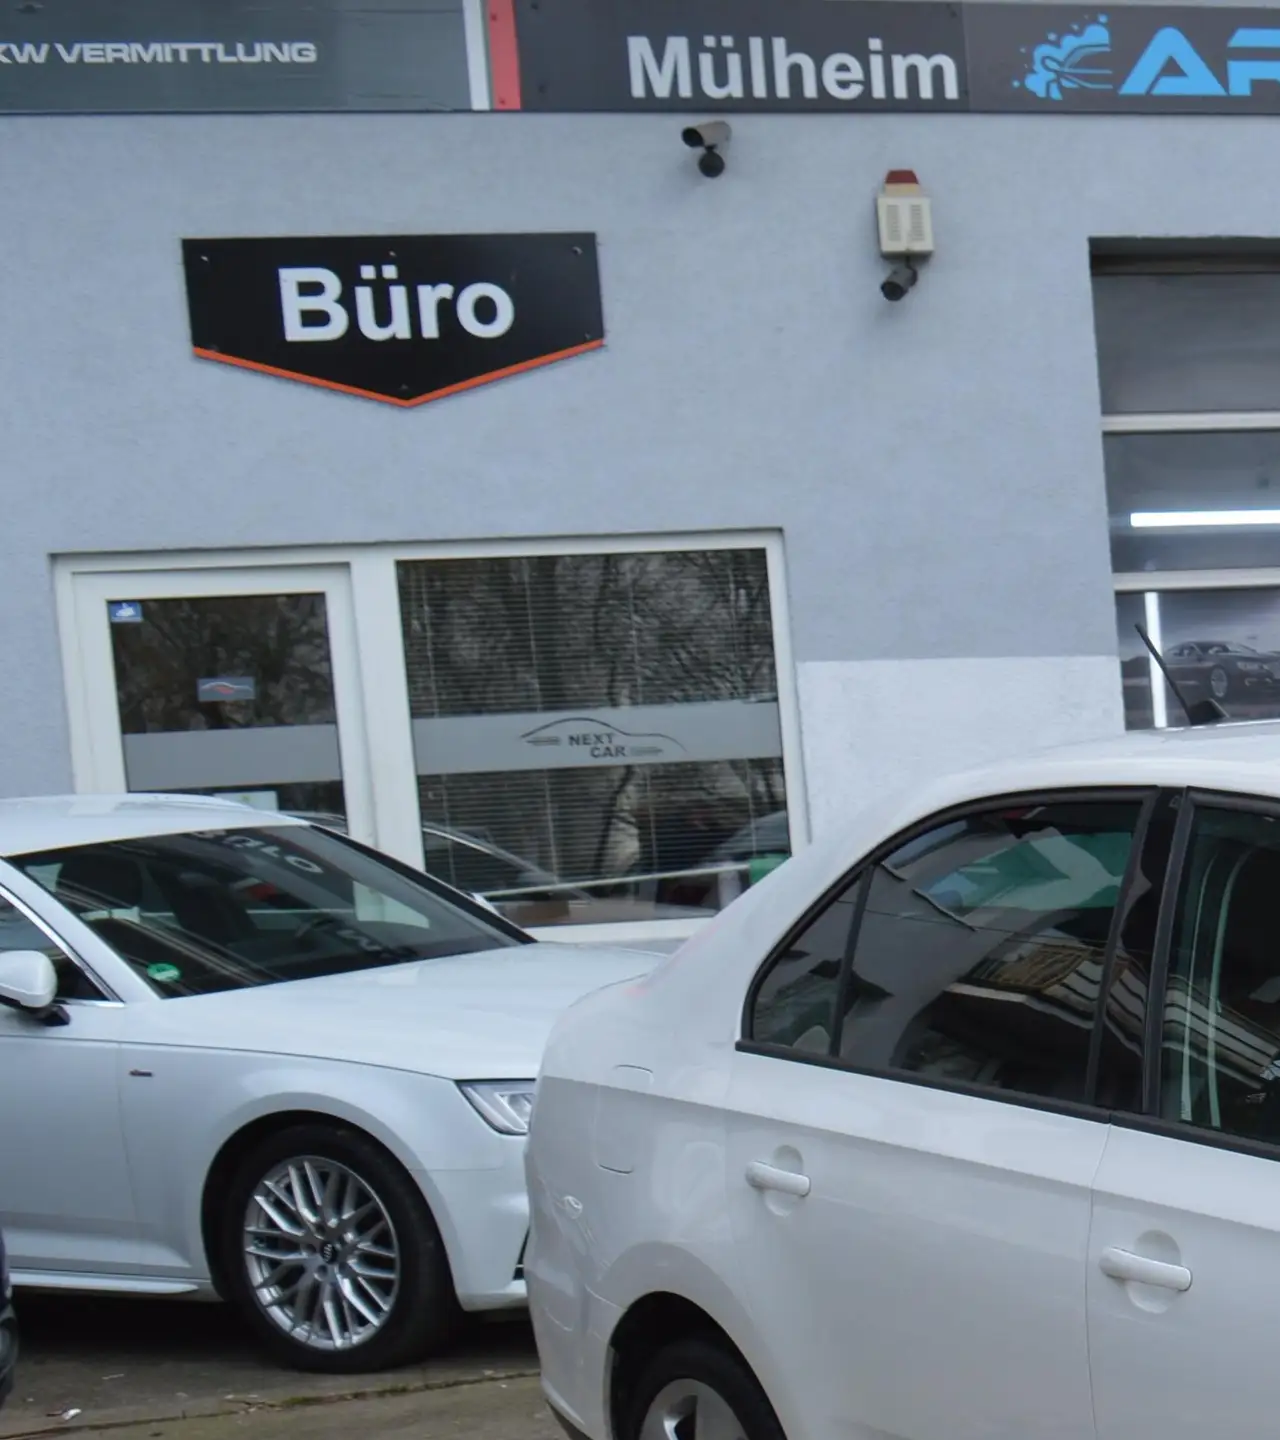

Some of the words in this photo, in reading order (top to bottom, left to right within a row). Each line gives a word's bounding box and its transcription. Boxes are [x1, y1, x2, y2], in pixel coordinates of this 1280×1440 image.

[53, 43, 317, 63] VERMITTLUNG
[627, 35, 959, 99] Mülheim
[278, 264, 515, 342] Büro
[568, 733, 615, 747] NEXT
[590, 746, 626, 758] CAR
